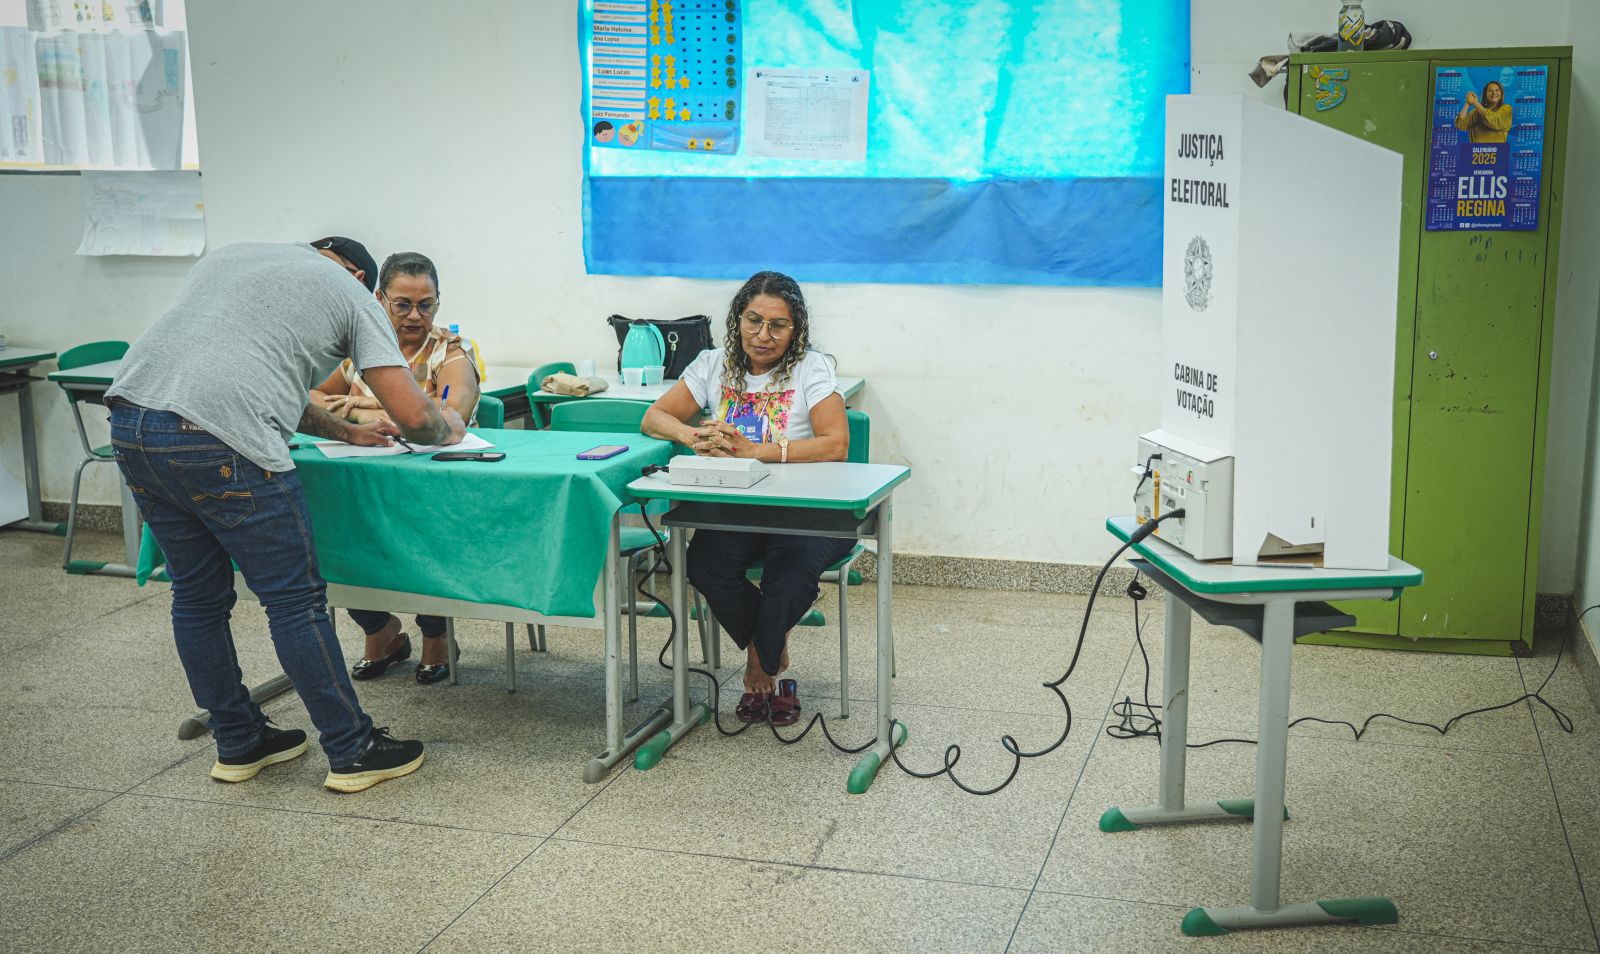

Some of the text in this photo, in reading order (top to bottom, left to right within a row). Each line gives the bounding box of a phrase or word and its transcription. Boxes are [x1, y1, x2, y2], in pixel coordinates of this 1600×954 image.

[1178, 133, 1224, 167] JUSTIÇA
[1472, 152, 1497, 165] 2025
[1171, 178, 1229, 209] ELEITORAL
[1457, 175, 1508, 199] ELLIS
[1456, 199, 1506, 217] REGINA
[1174, 362, 1218, 393] CABINA DE
[1177, 388, 1214, 419] VOTAÇÃO
